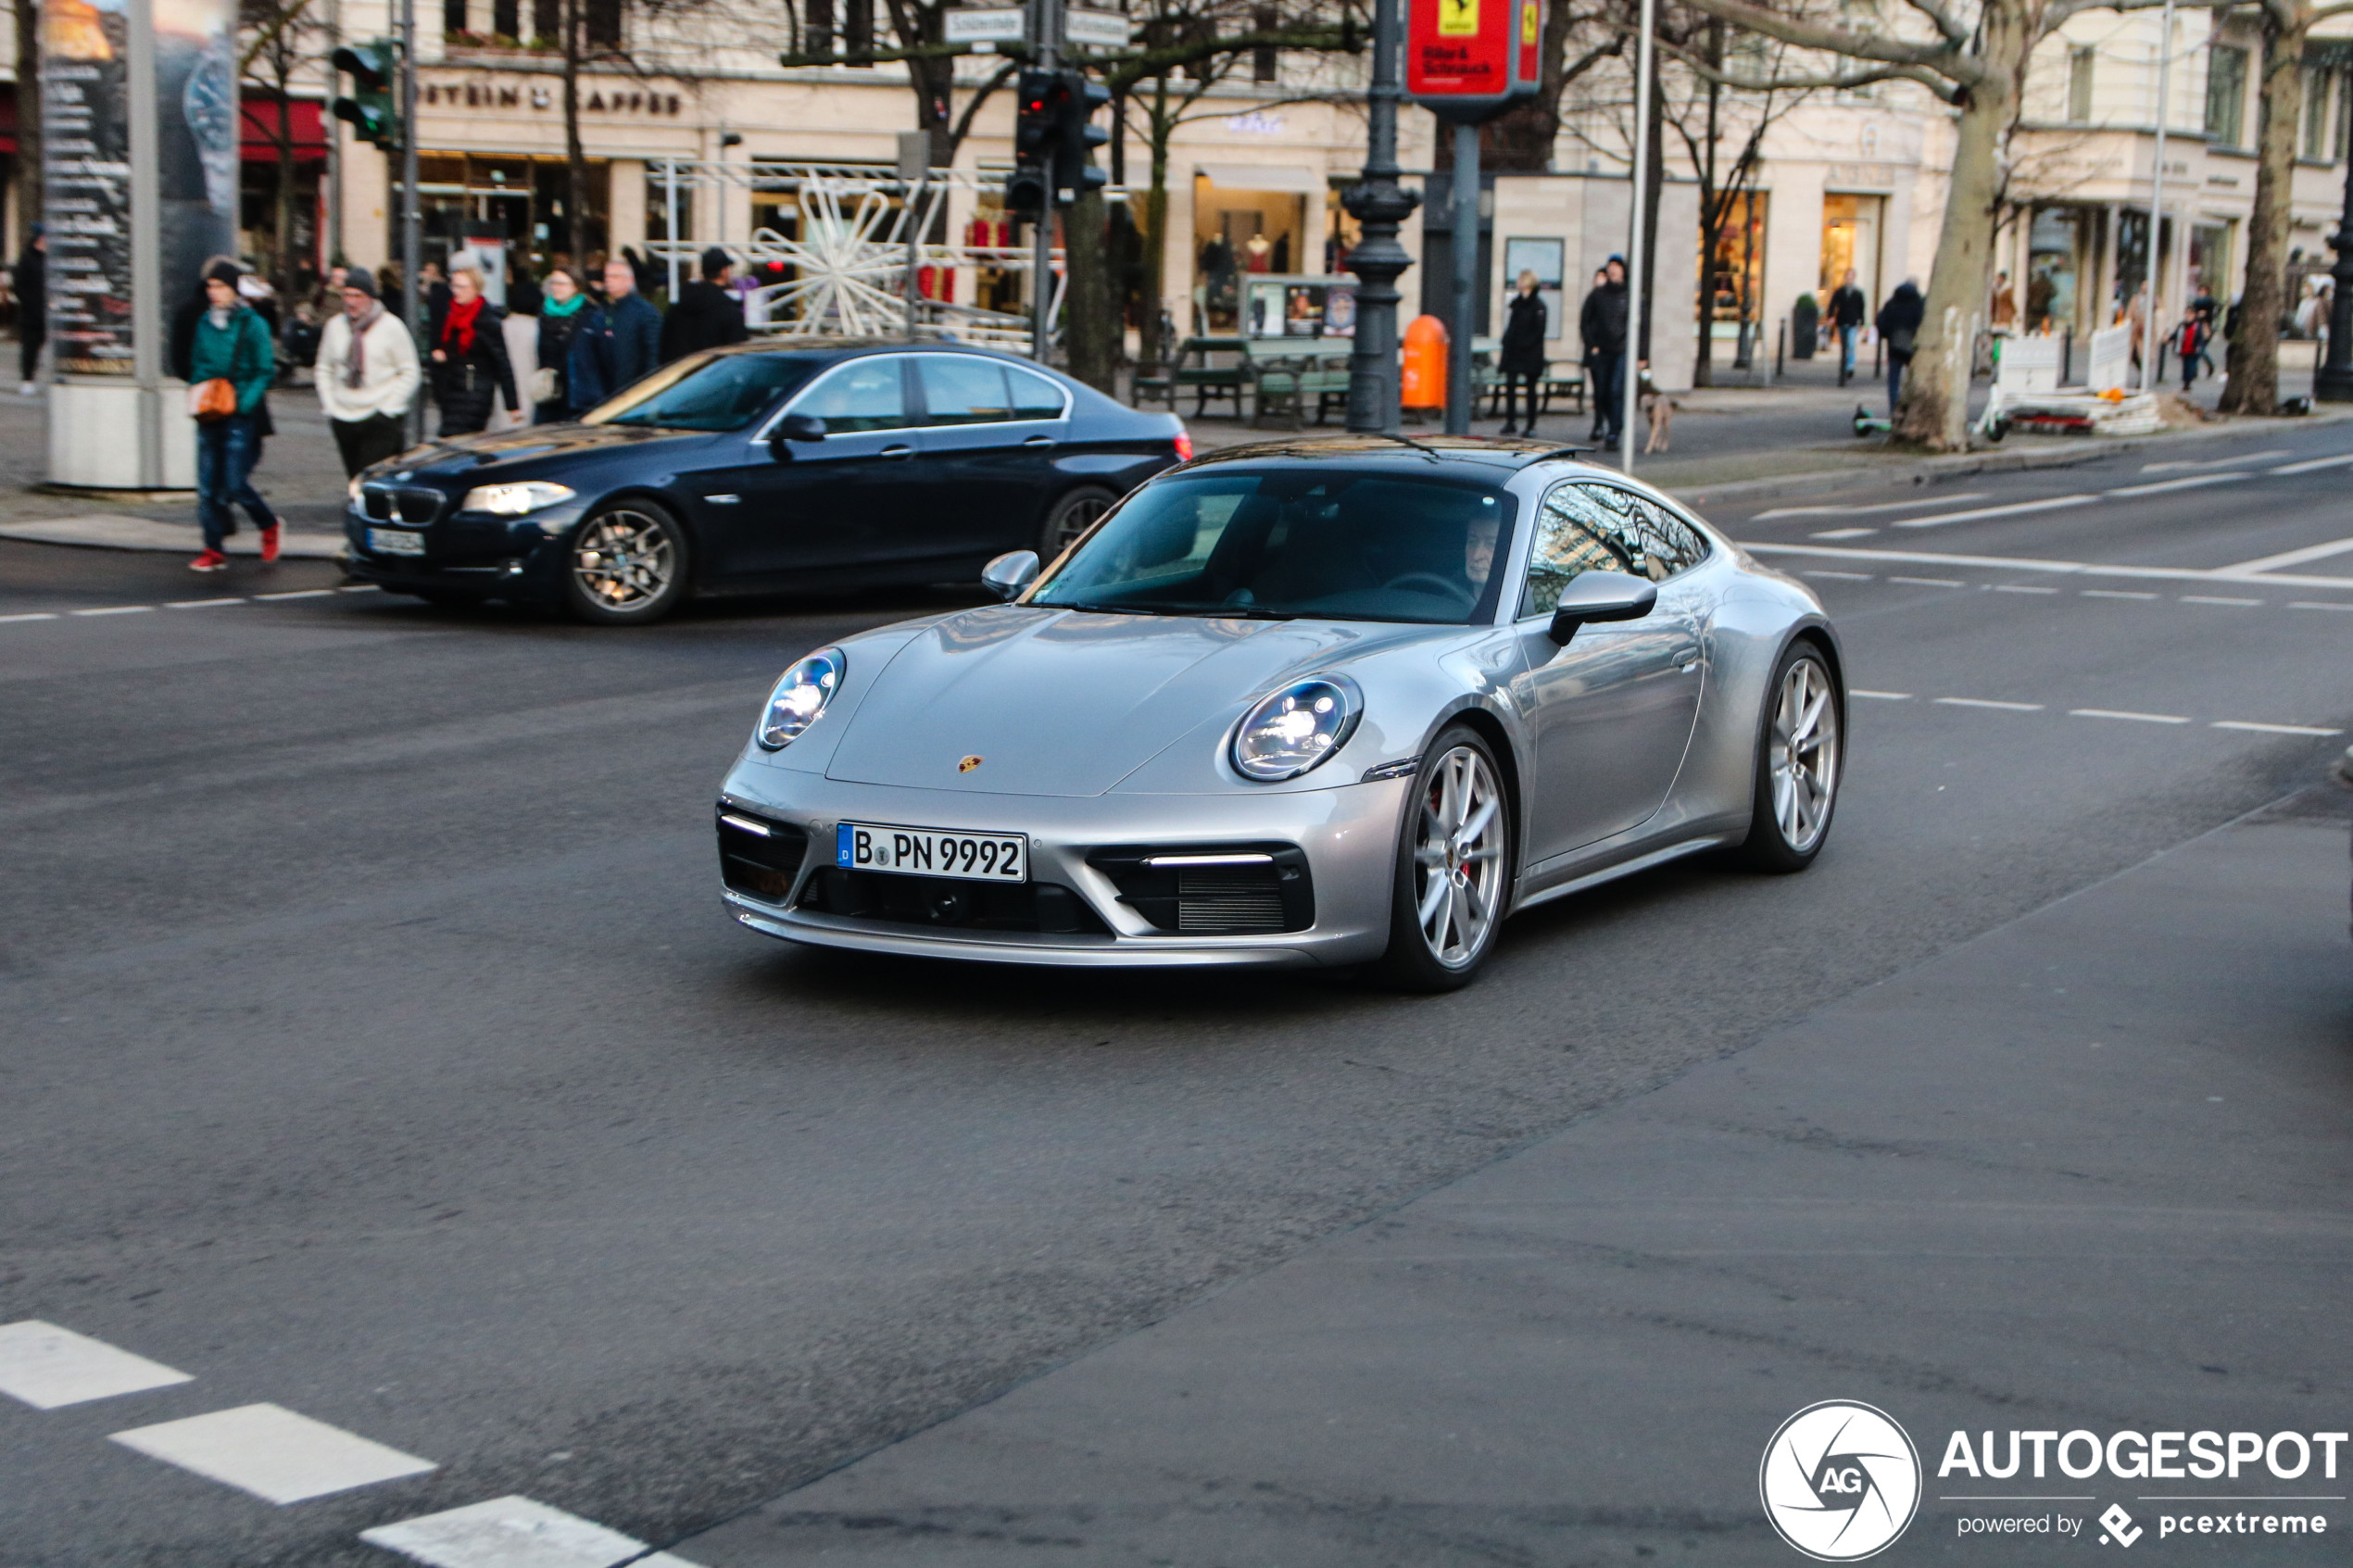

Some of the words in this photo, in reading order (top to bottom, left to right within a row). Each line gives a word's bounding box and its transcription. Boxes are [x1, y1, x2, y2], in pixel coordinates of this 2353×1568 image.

[573, 91, 681, 116] AFFEE
[855, 830, 873, 864] B
[894, 834, 932, 870] PN
[940, 837, 1019, 875] 9992
